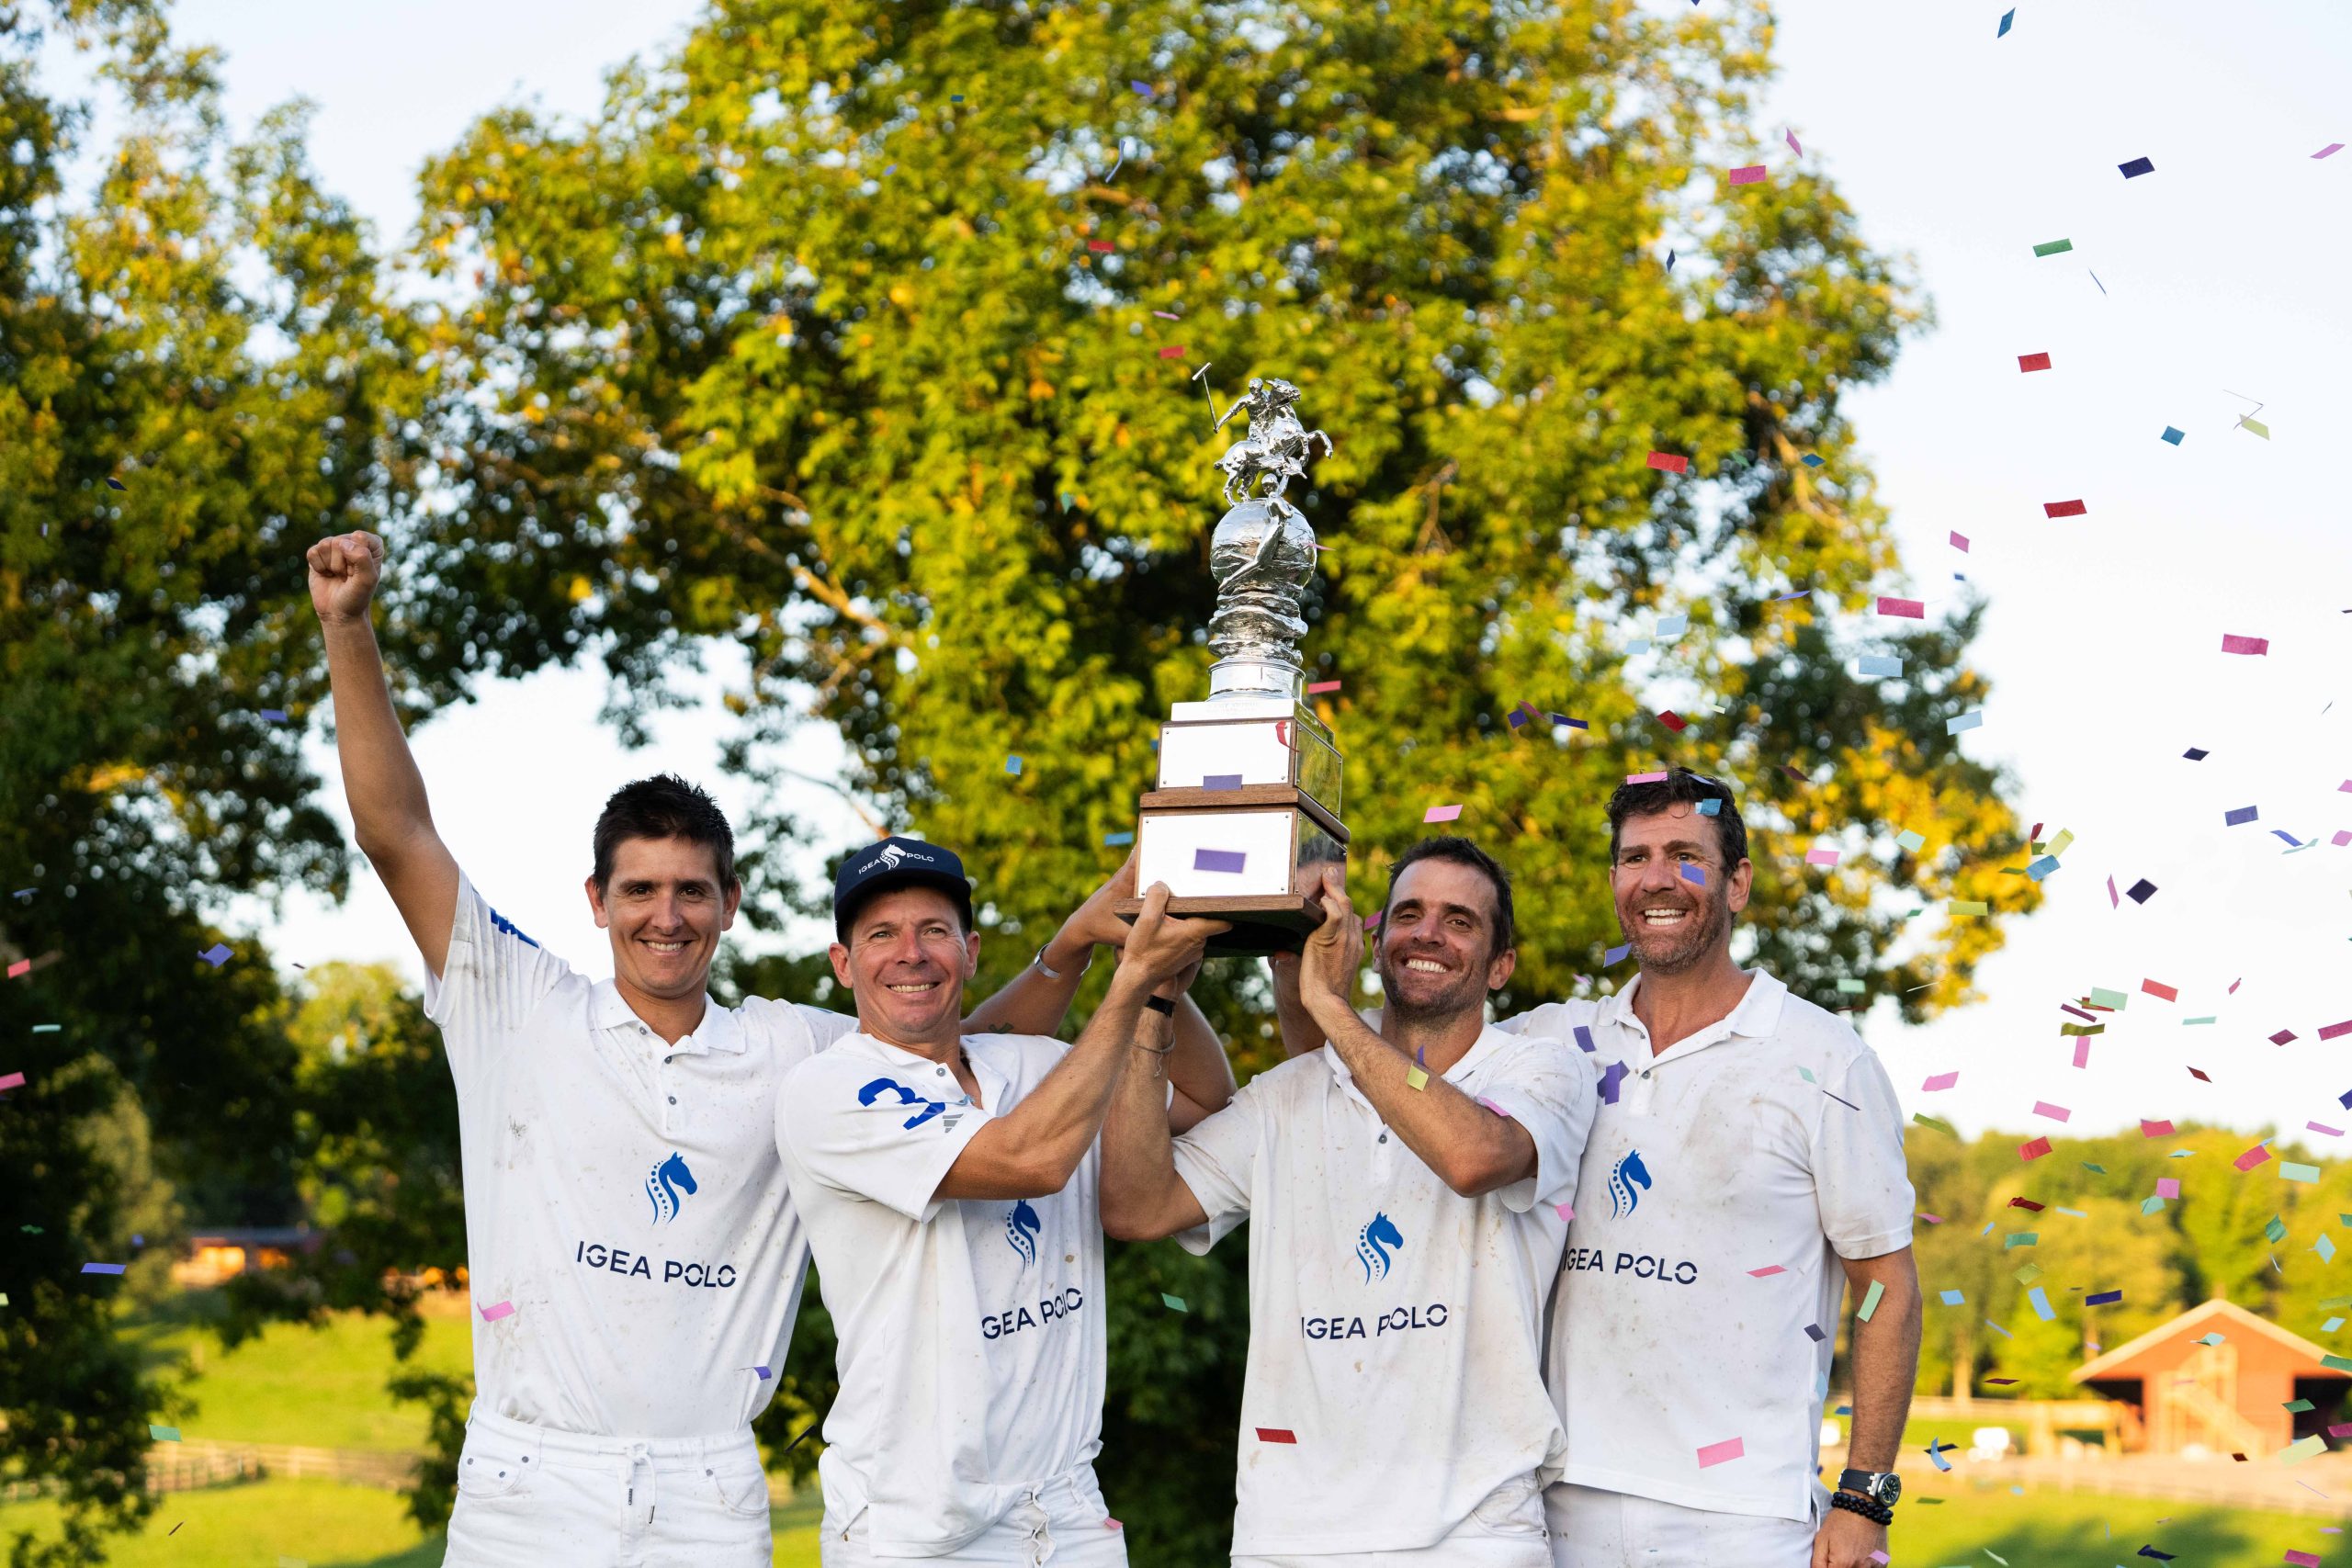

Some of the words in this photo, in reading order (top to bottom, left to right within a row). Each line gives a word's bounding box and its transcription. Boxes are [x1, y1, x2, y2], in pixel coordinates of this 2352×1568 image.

[858, 859, 881, 874] IGEA
[906, 852, 934, 863] POLO
[576, 1240, 651, 1280] IGEA
[663, 1260, 737, 1288] POLO
[1563, 1247, 1604, 1272] IGEA
[1614, 1252, 1698, 1285] POLO
[981, 1306, 1036, 1339] GEA
[1301, 1316, 1366, 1340] IGEA
[1376, 1303, 1448, 1337] POLO
